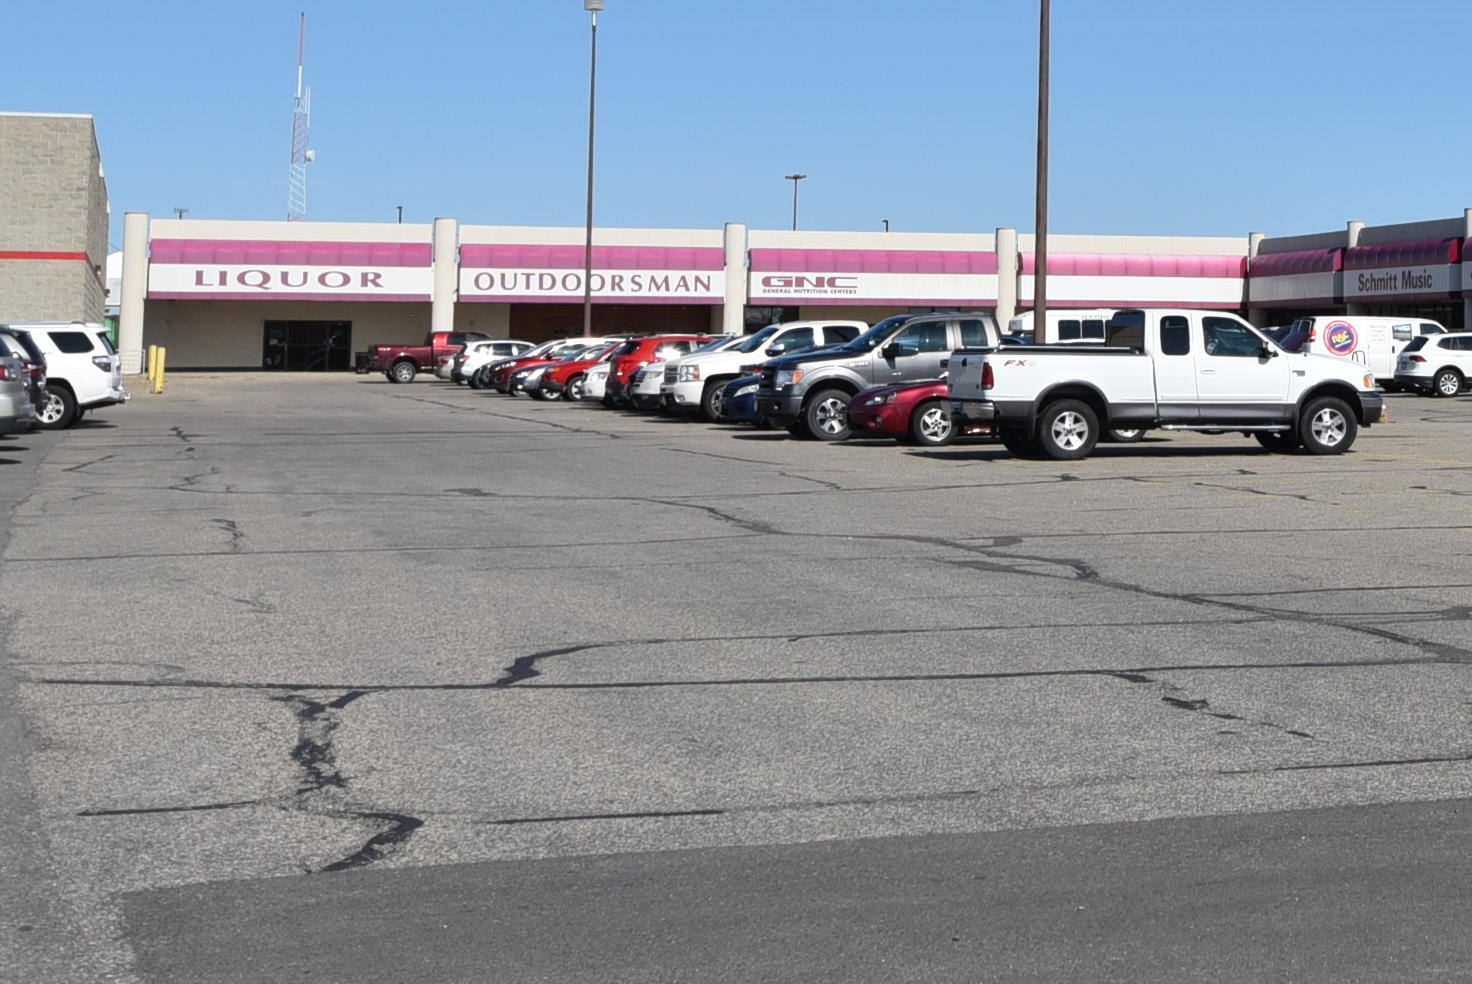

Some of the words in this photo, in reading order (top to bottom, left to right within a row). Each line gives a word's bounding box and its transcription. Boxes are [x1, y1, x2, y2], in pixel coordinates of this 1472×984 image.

[194, 269, 385, 290] LIQUOR
[473, 272, 711, 293] OUTDOORSMAN
[761, 275, 858, 288] GNC
[1357, 272, 1398, 292] Schmitt
[1401, 268, 1433, 290] Music
